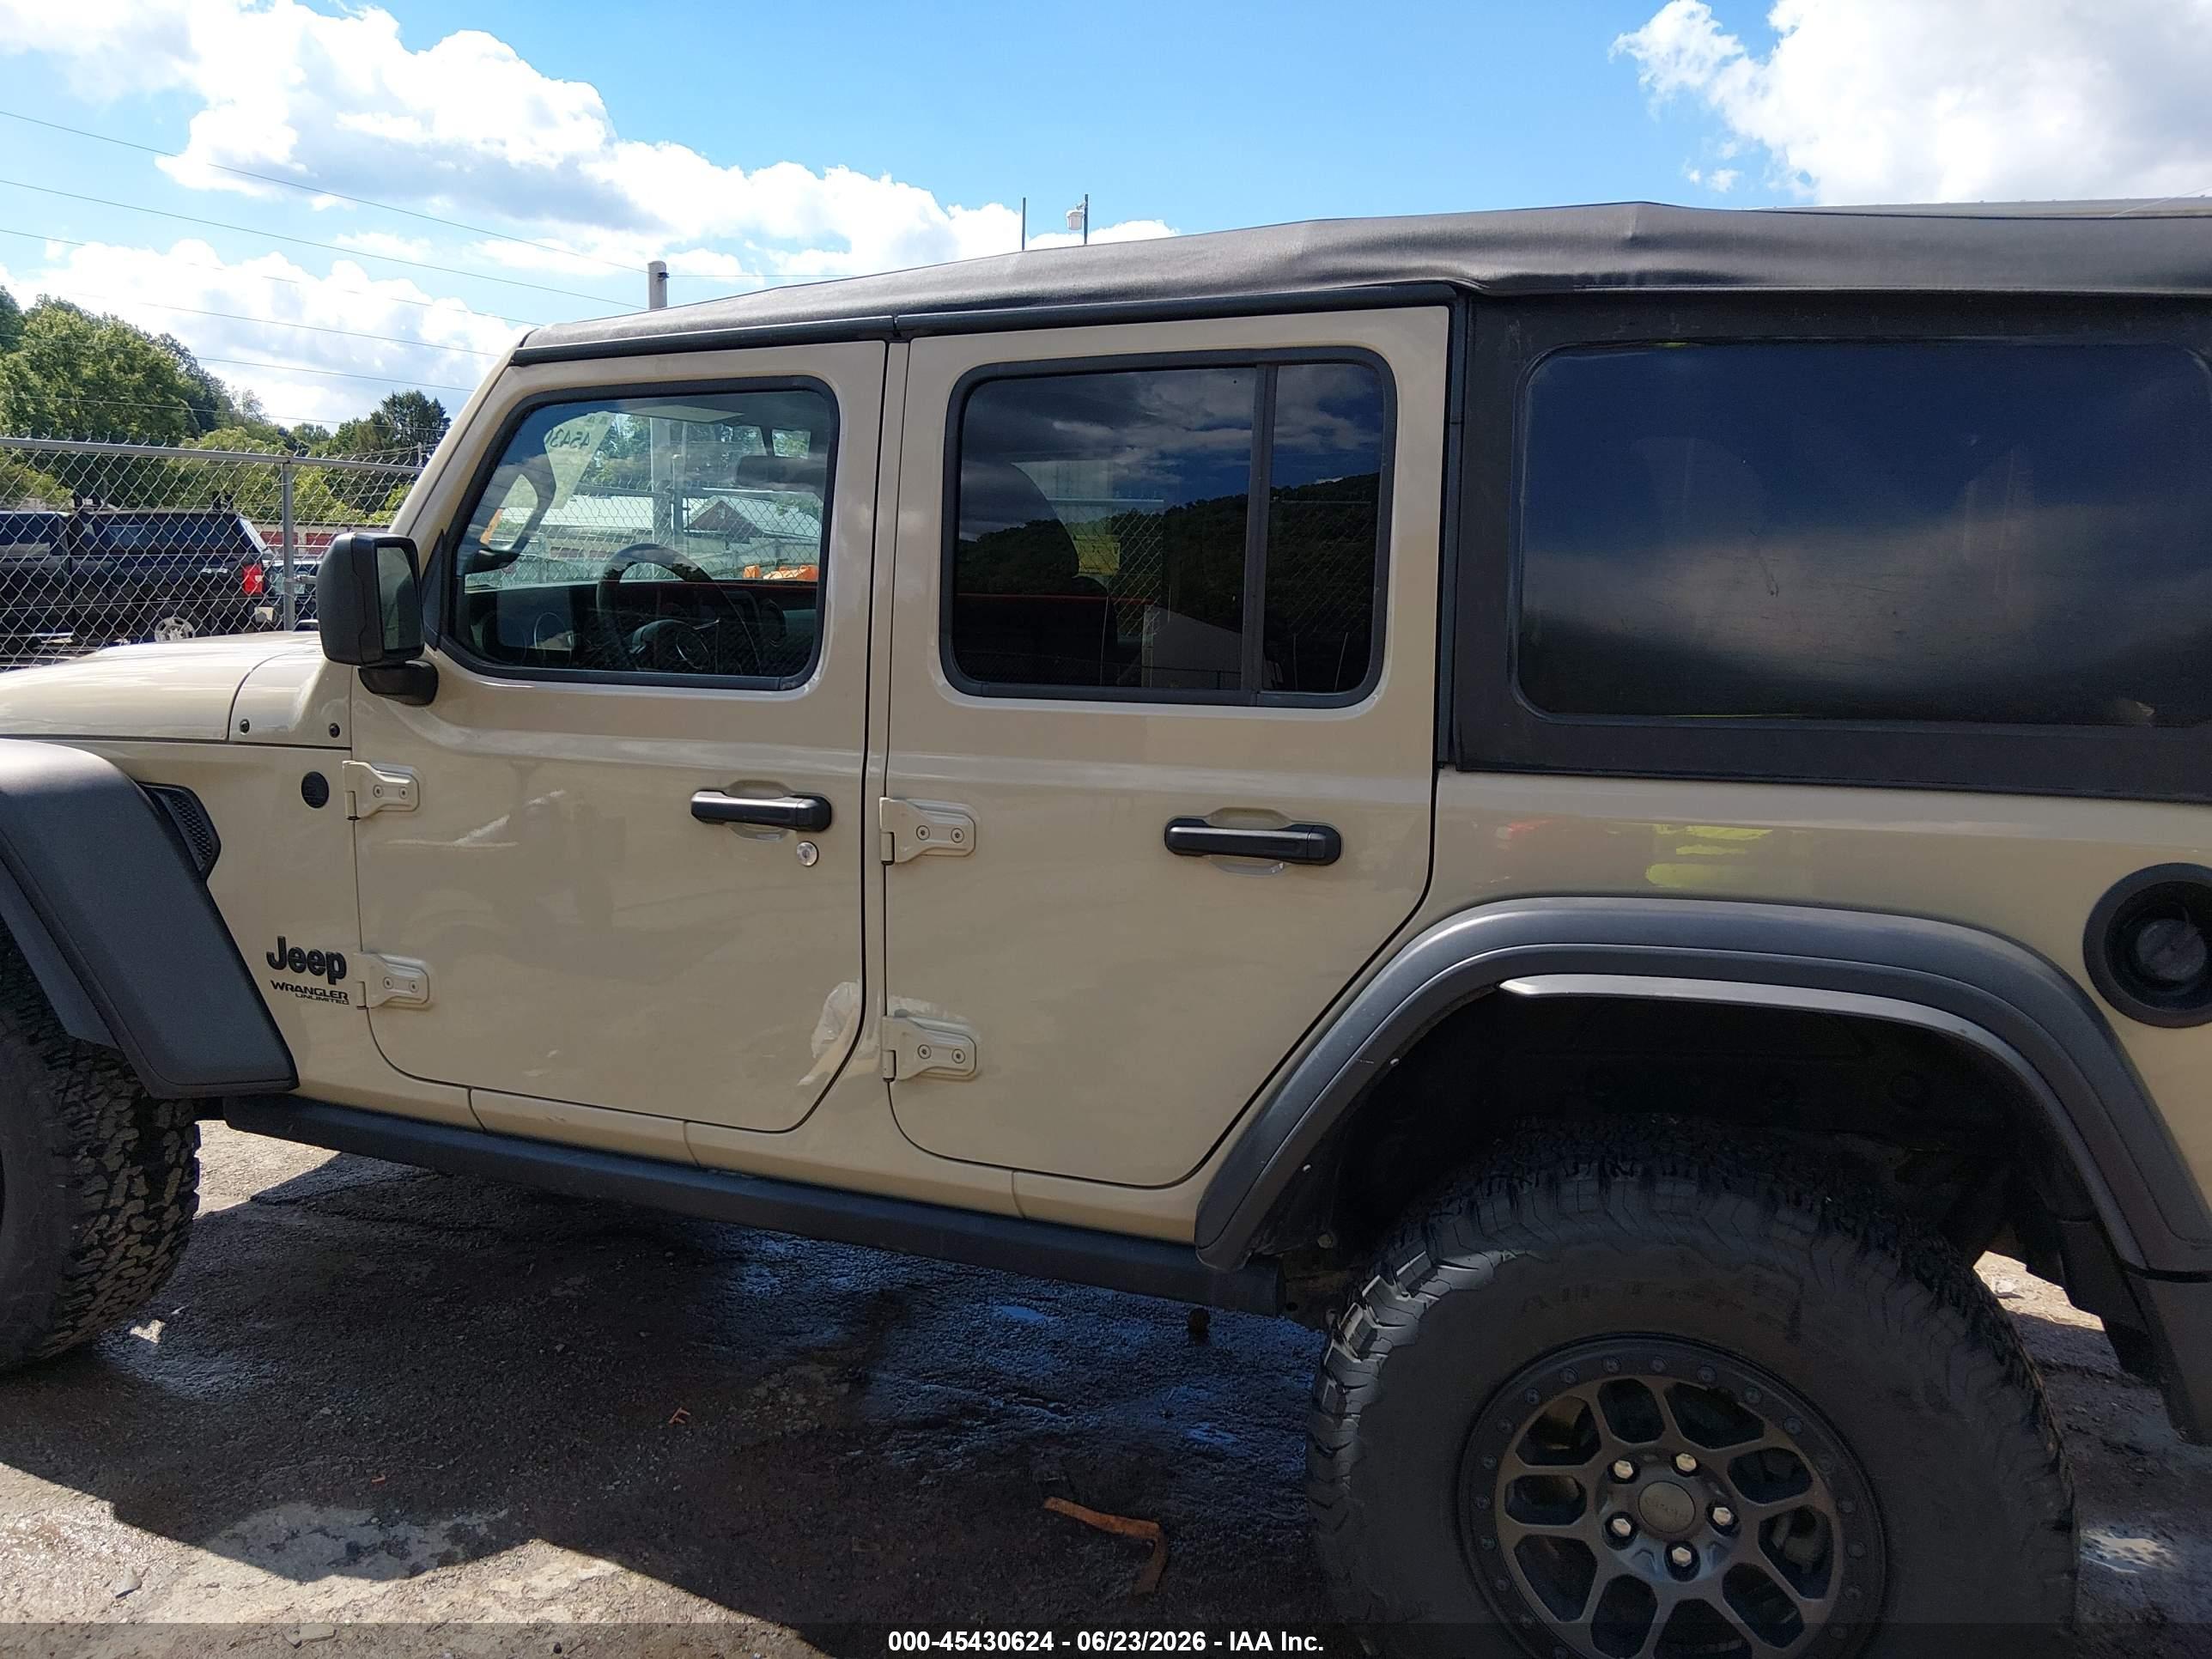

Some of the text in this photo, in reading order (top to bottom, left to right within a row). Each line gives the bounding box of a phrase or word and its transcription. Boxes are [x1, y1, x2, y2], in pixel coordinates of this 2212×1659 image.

[266, 935, 347, 986] Jeep
[270, 980, 349, 1001] WRANGLER
[295, 993, 349, 1006] UNLIMITED
